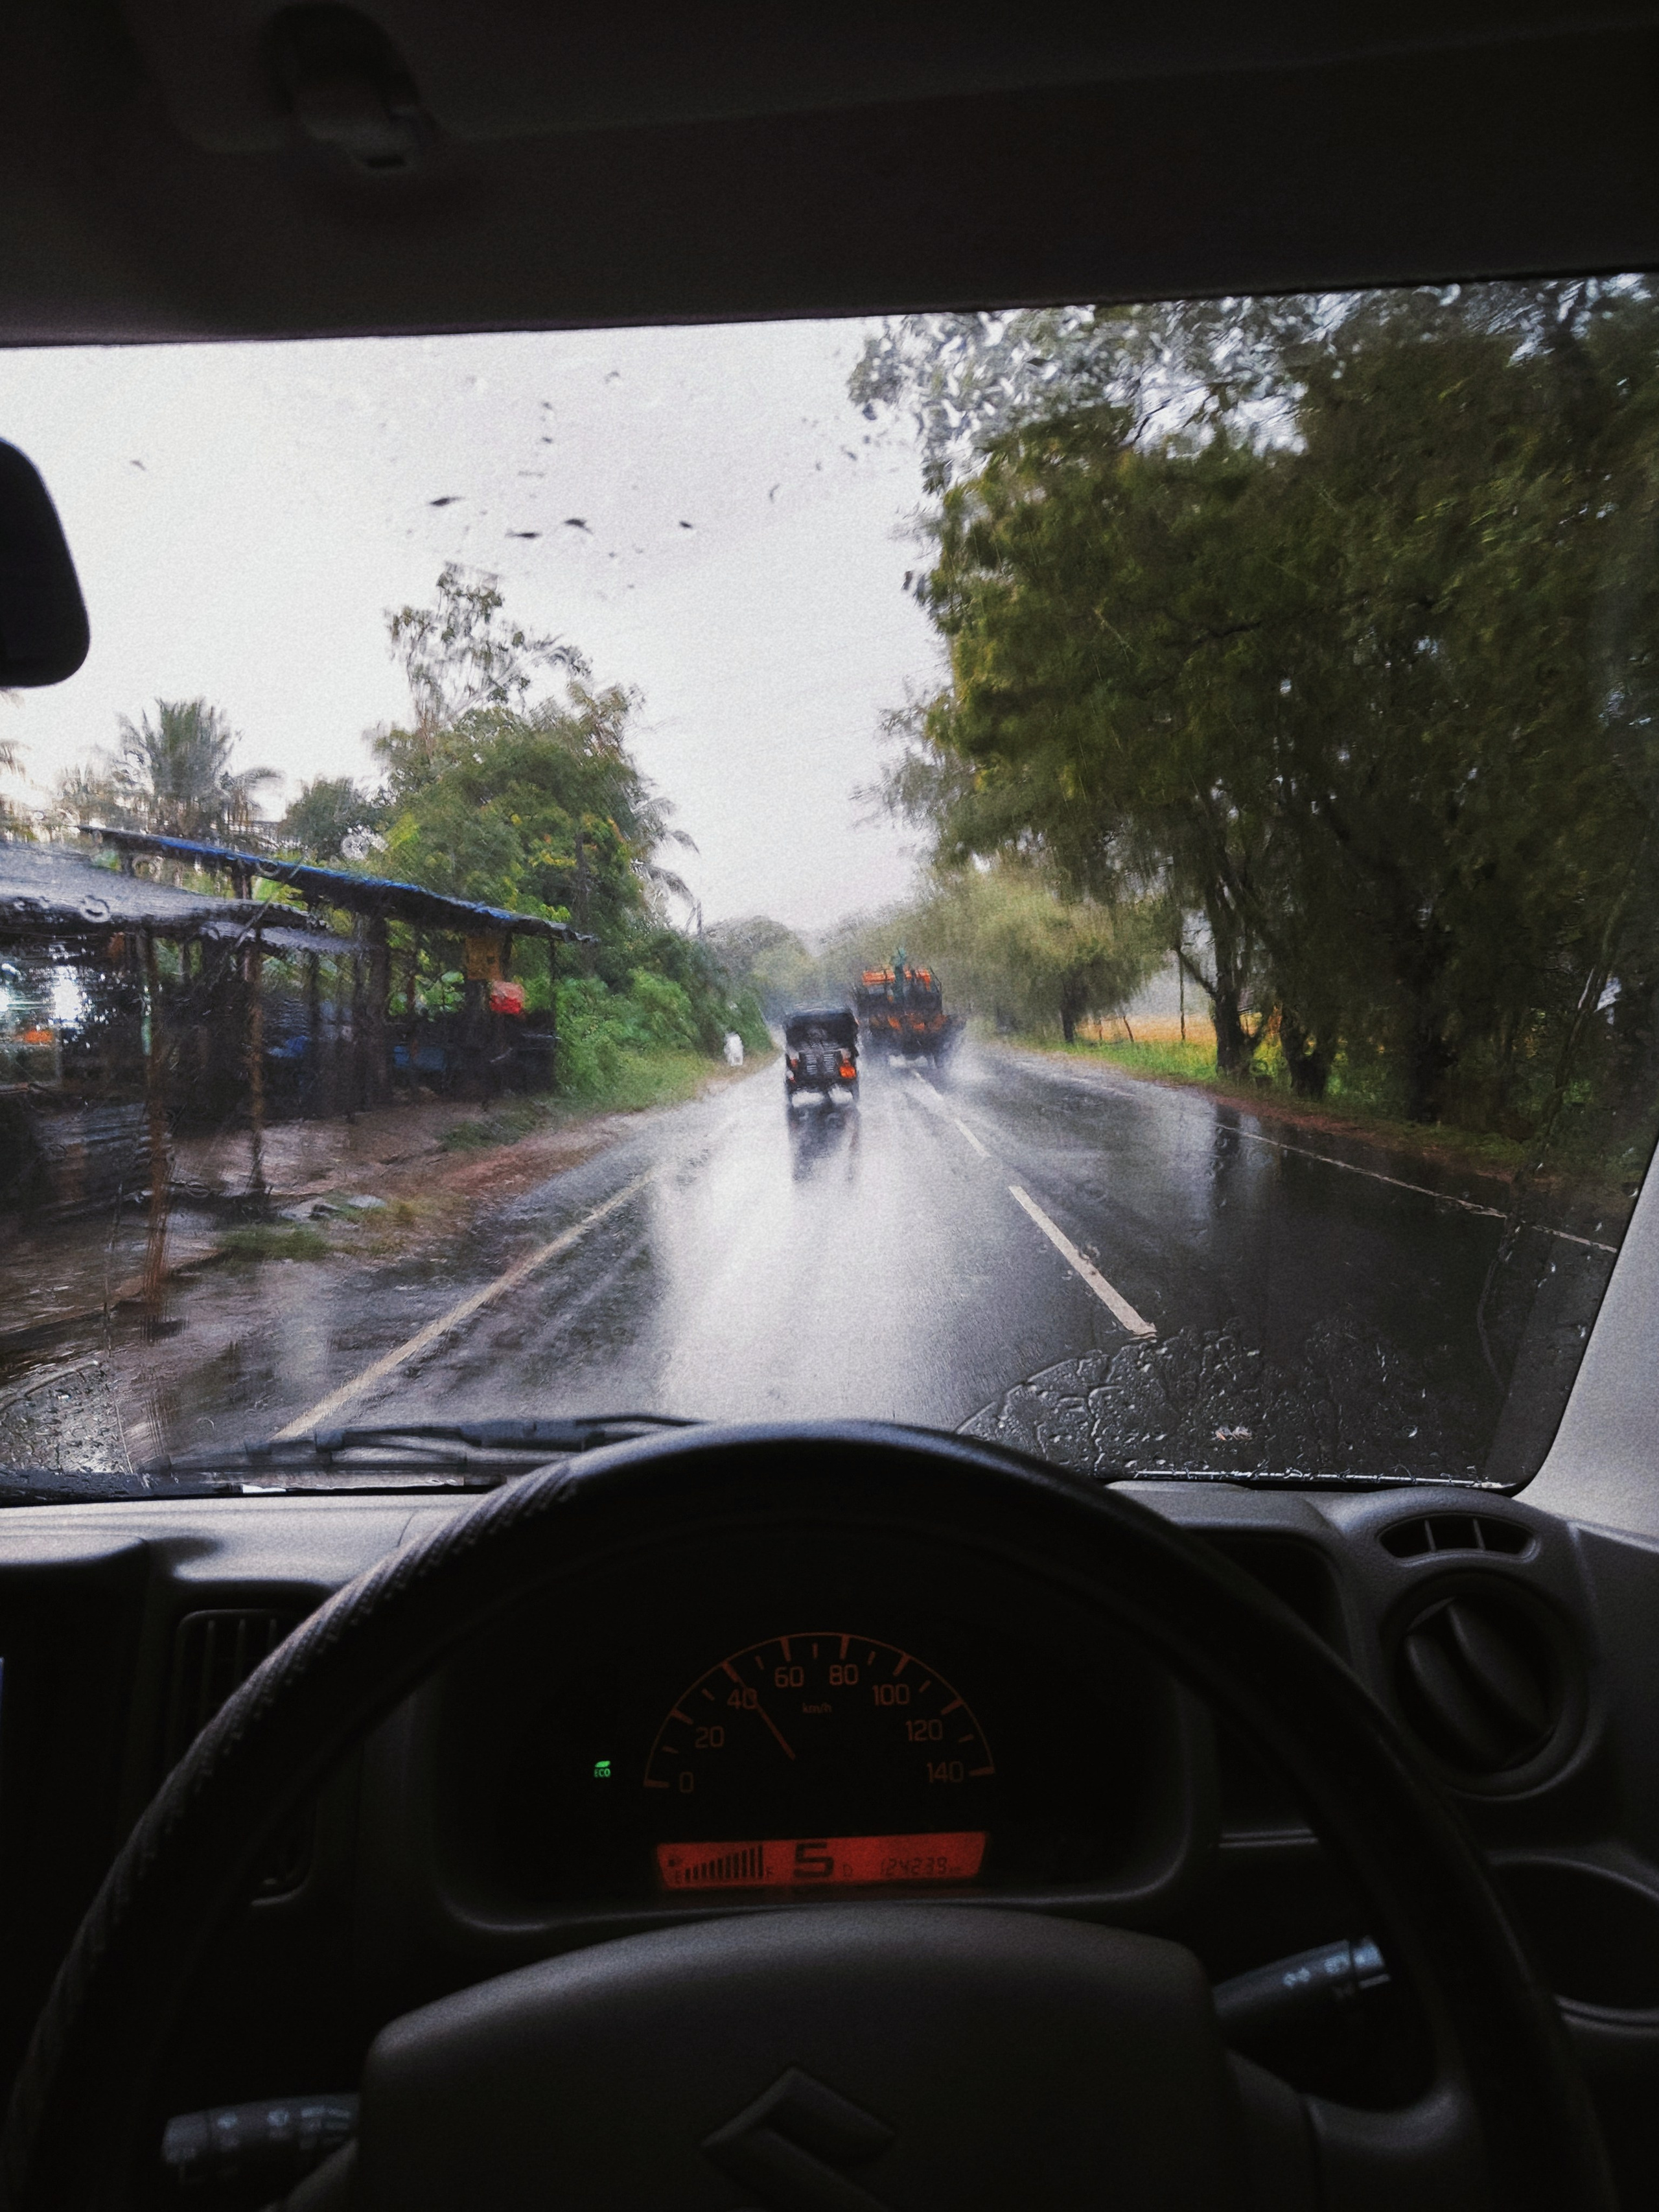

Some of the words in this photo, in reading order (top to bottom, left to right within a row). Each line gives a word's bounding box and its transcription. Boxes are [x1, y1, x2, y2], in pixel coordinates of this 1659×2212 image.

[774, 1666, 805, 1688] 60
[829, 1663, 859, 1686] 80
[727, 1688, 758, 1710] 40
[872, 1683, 911, 1706] 100
[801, 1702, 833, 1714] km/h
[694, 1725, 725, 1749] 20
[905, 1718, 944, 1742] 120
[594, 1767, 611, 1778] ECO
[679, 1771, 694, 1794] 0
[926, 1760, 964, 1784] 140
